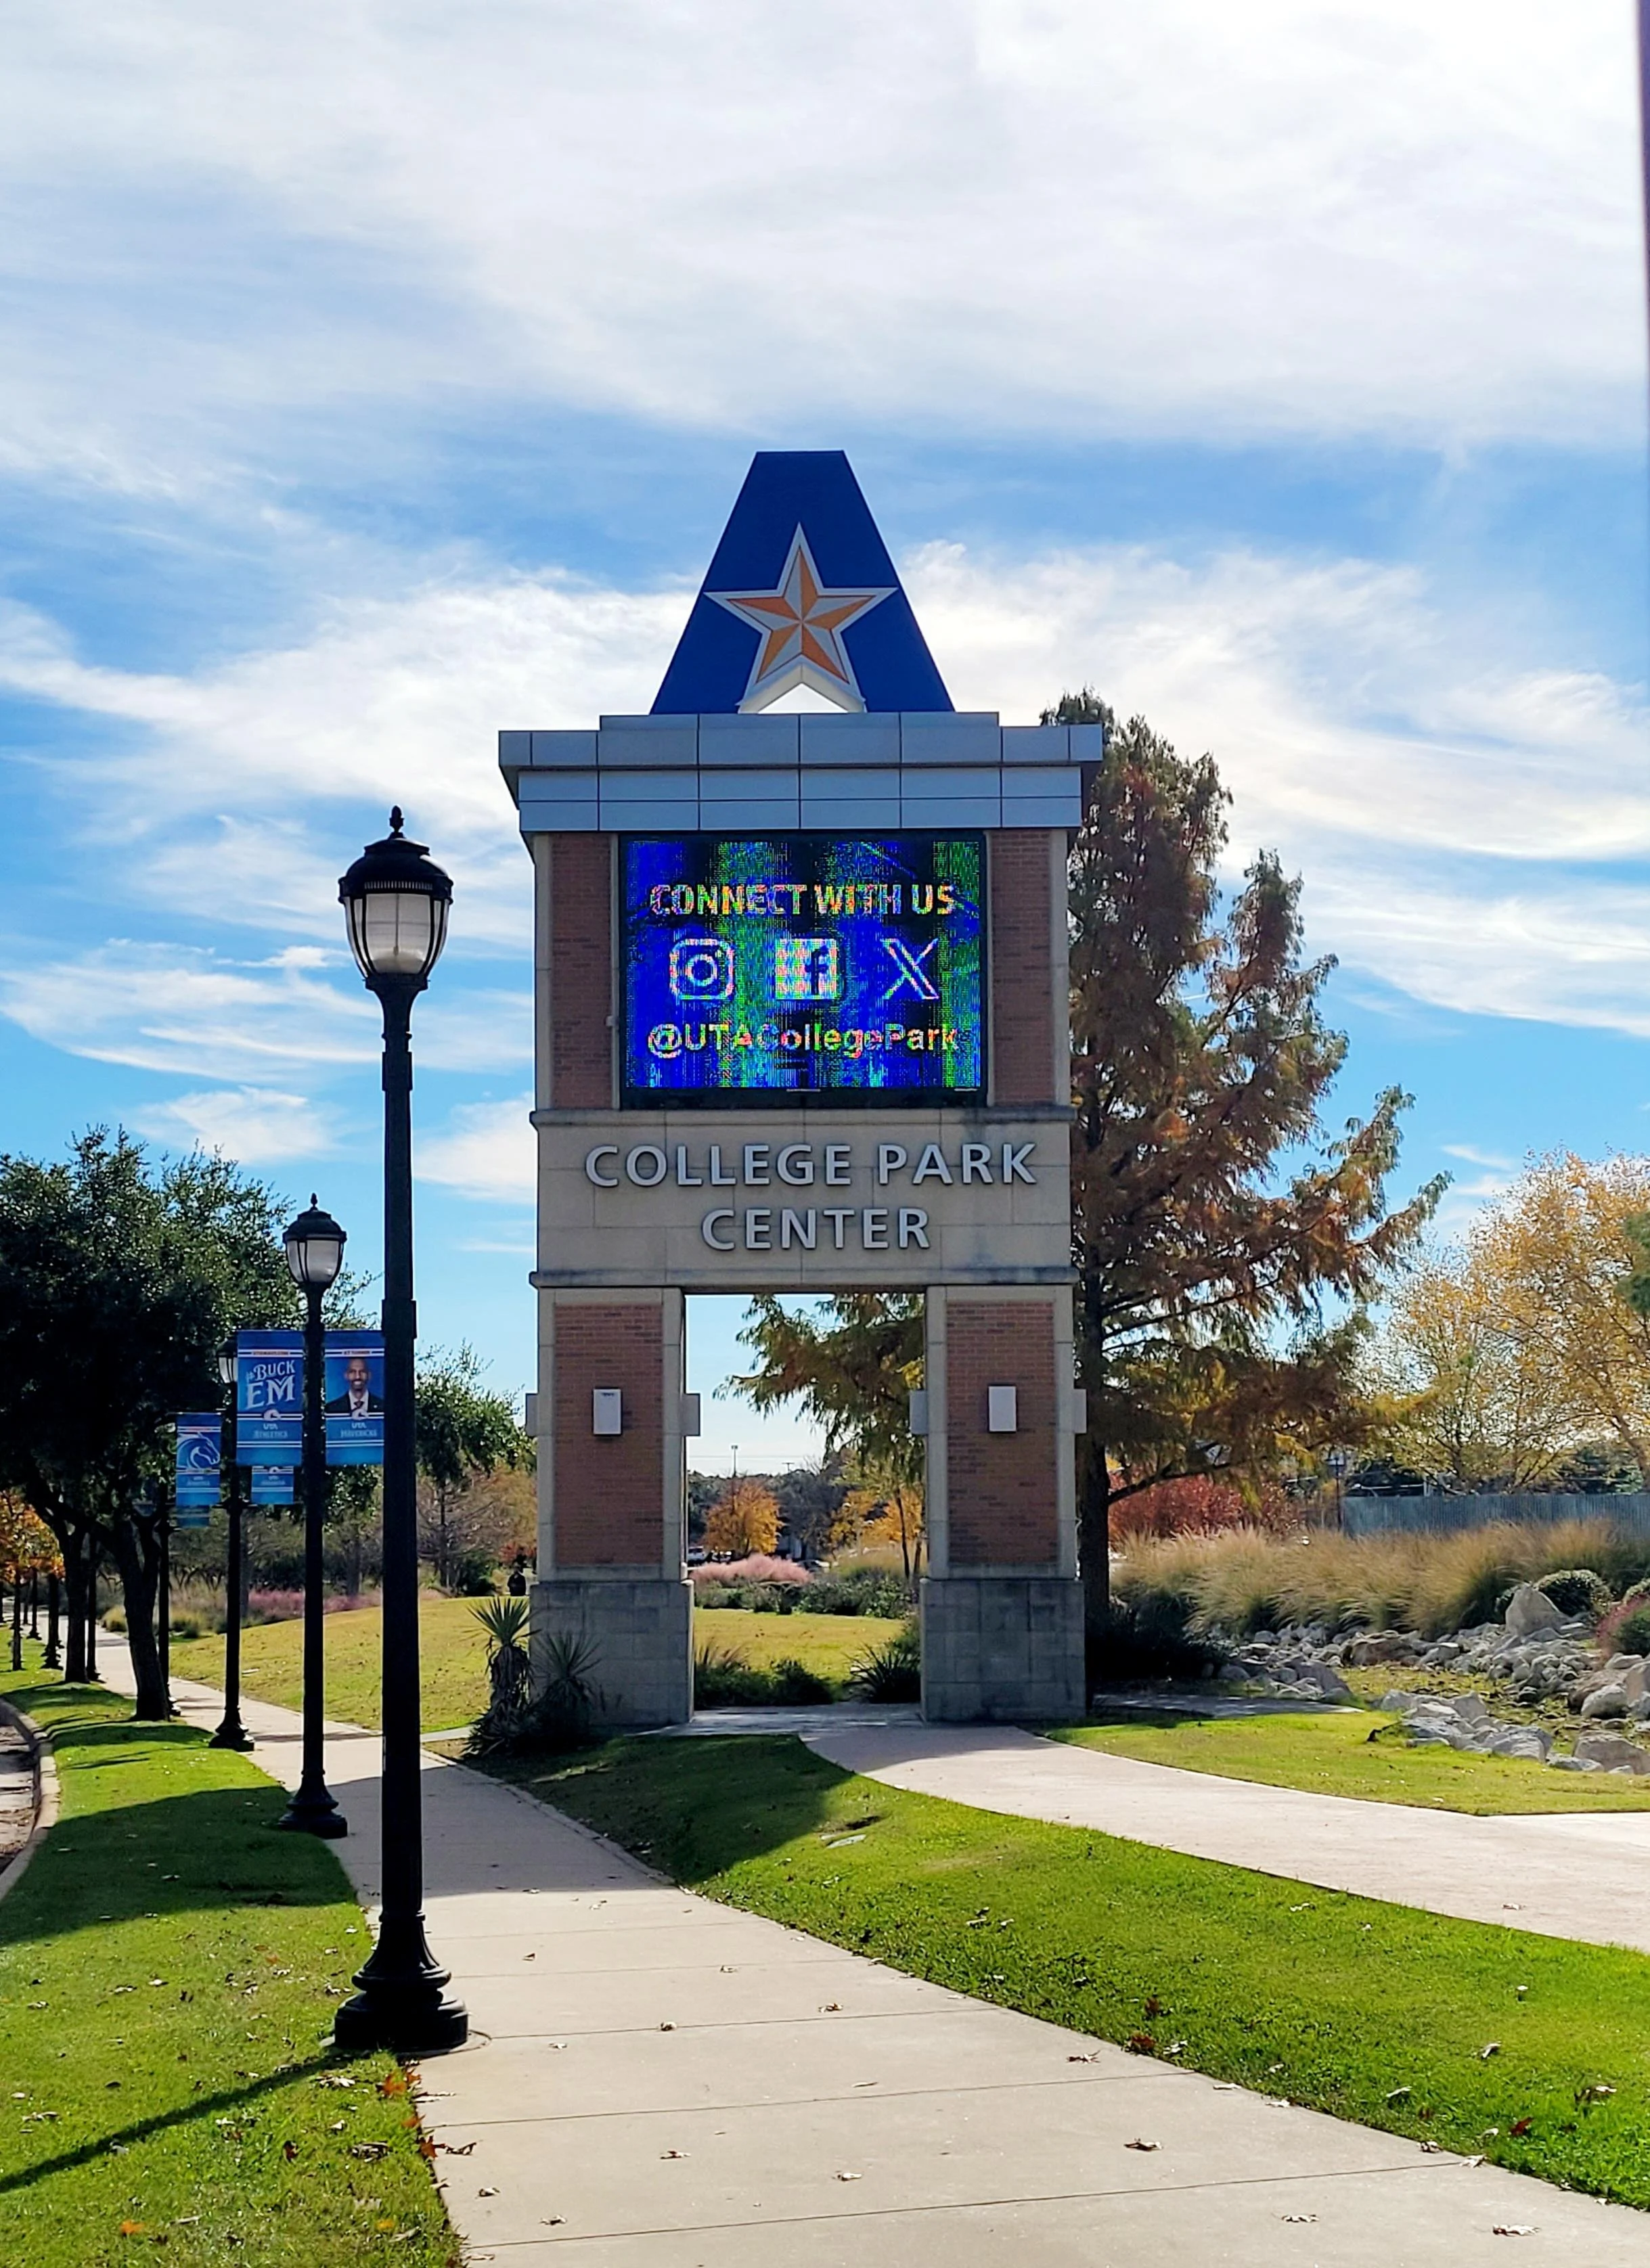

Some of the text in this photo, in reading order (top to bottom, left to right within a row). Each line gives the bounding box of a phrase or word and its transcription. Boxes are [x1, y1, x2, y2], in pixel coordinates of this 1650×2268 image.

[650, 884, 955, 915] CONNECT WITH US
[648, 1023, 959, 1059] @UTACollegePark
[585, 1143, 1037, 1187] COLLEGE PARK
[701, 1208, 931, 1250] CENTER
[245, 1375, 296, 1410] EM
